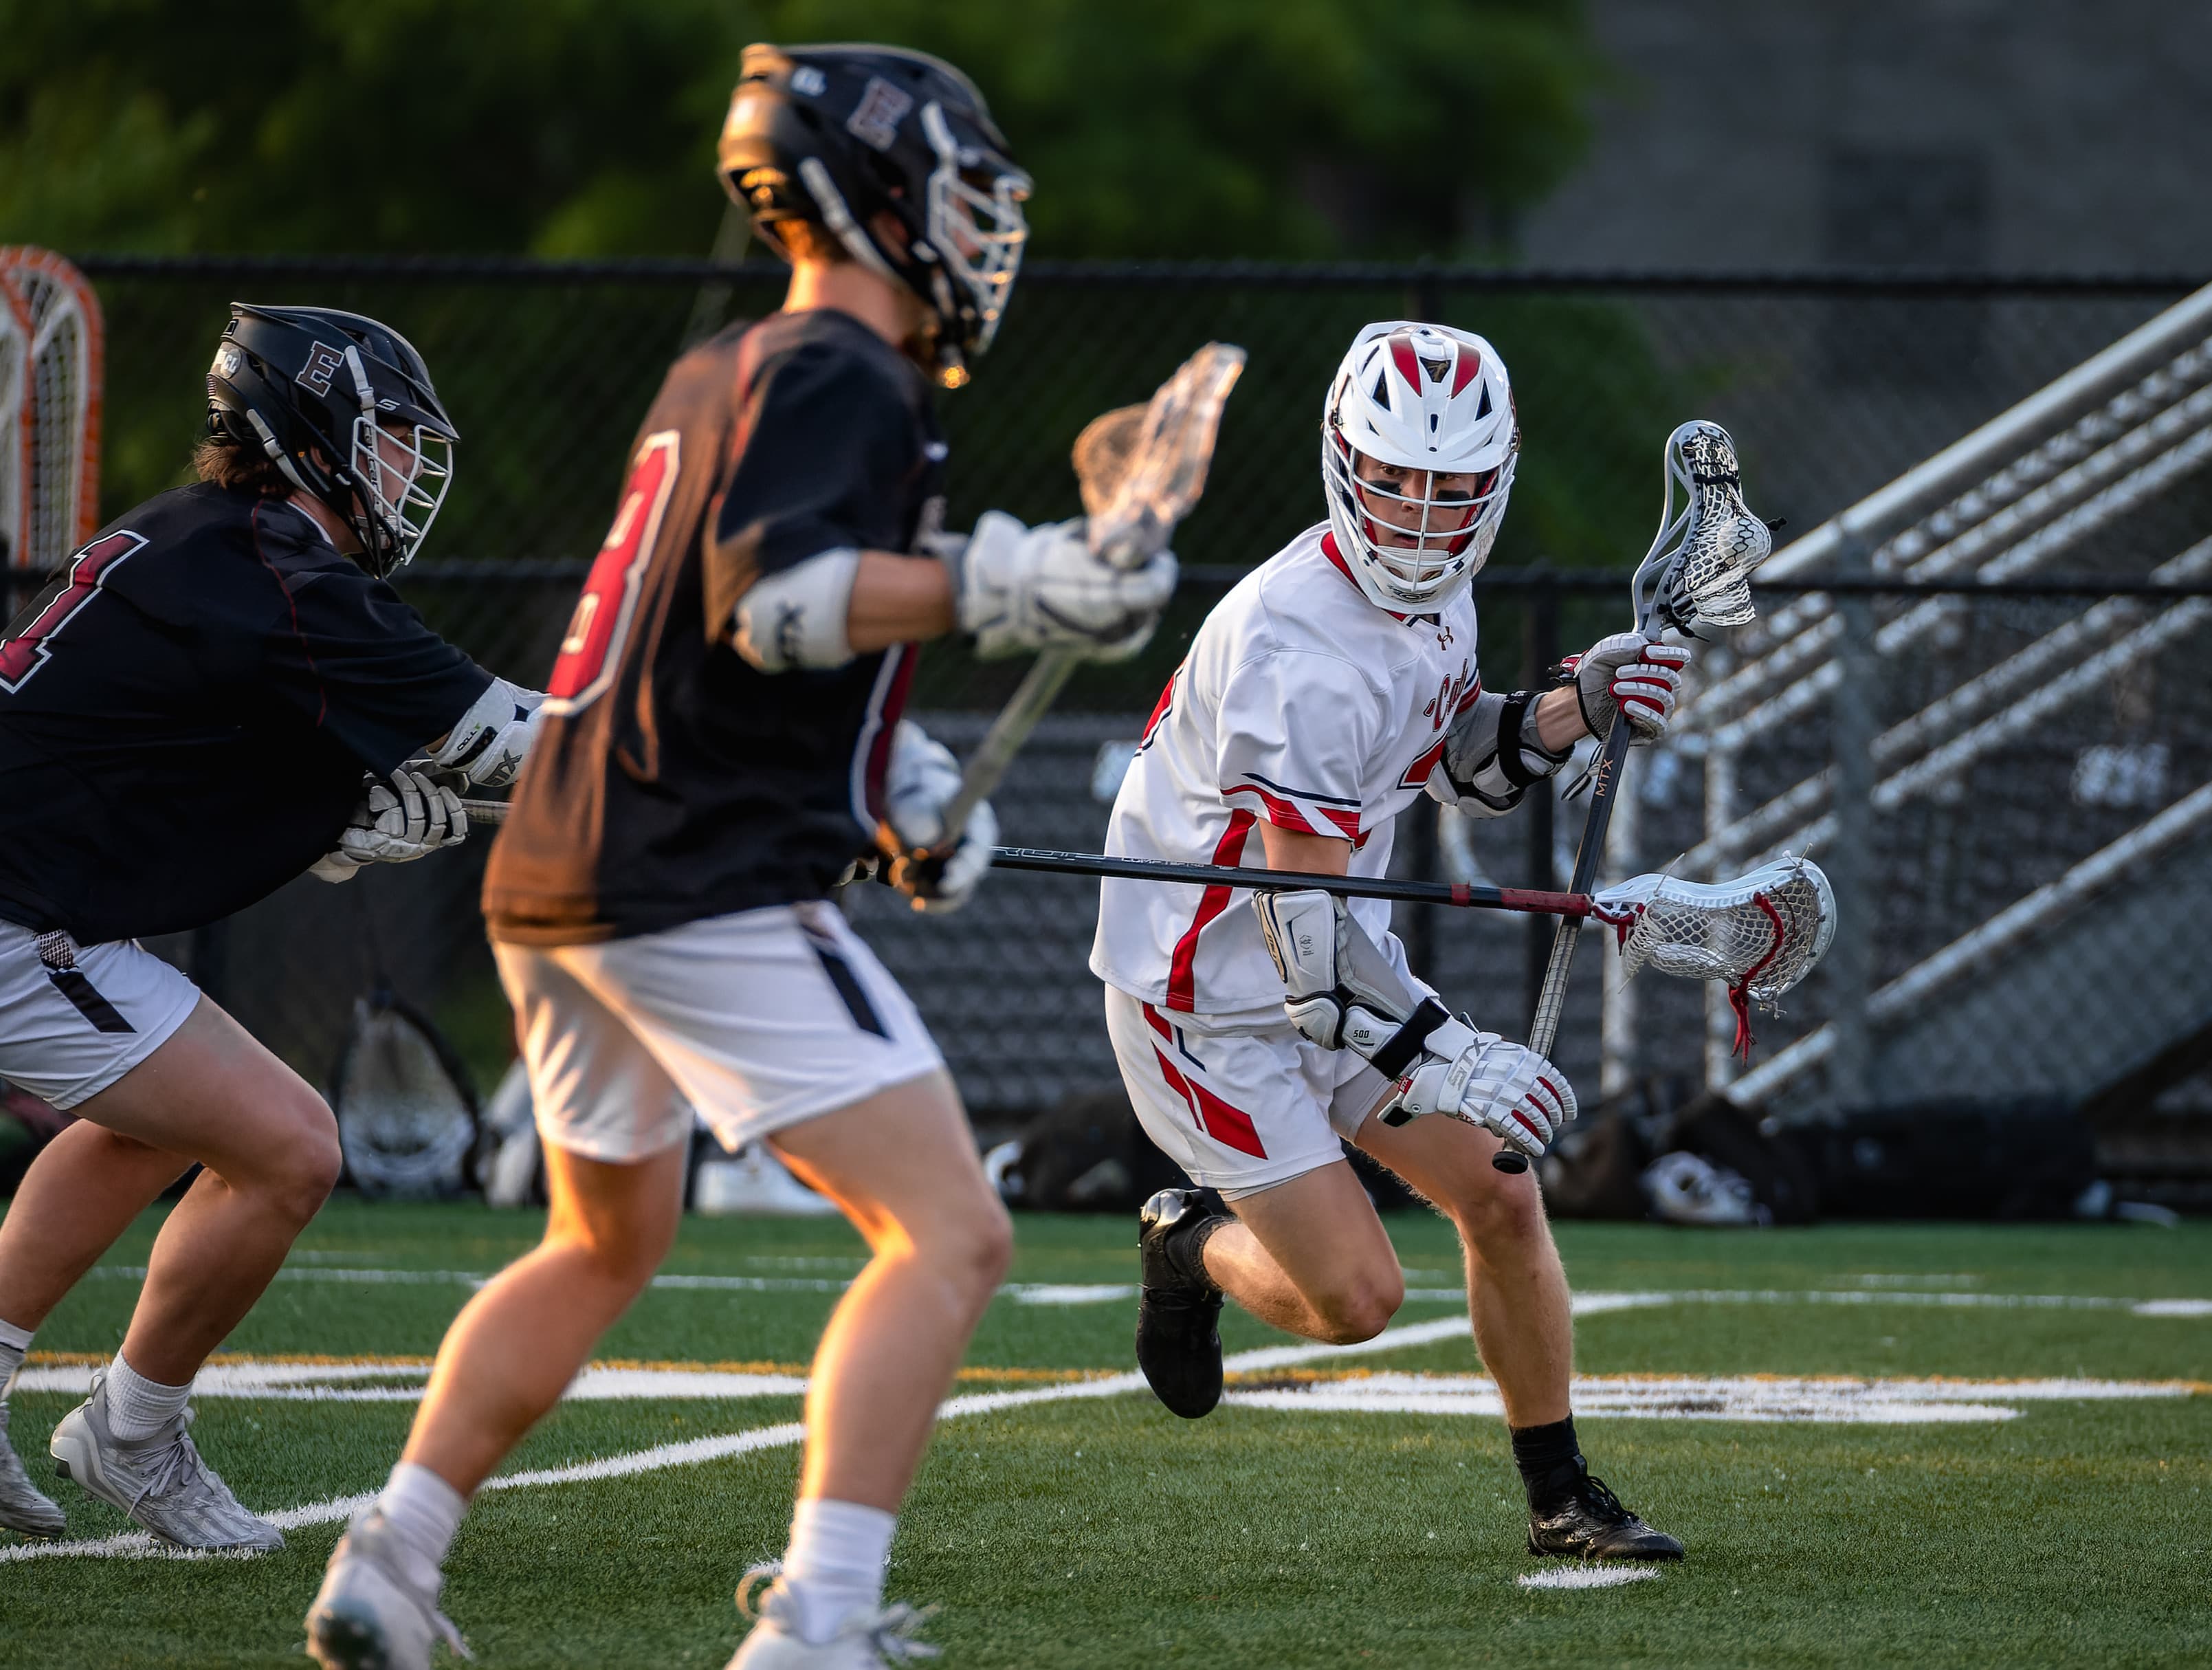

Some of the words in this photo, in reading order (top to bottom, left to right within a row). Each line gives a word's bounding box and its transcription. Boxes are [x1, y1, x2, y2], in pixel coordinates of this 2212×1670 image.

[295, 340, 346, 397] E
[1595, 758, 1614, 797] MTX
[1353, 1029, 1370, 1039] 500
[1447, 1036, 1490, 1092] STX
